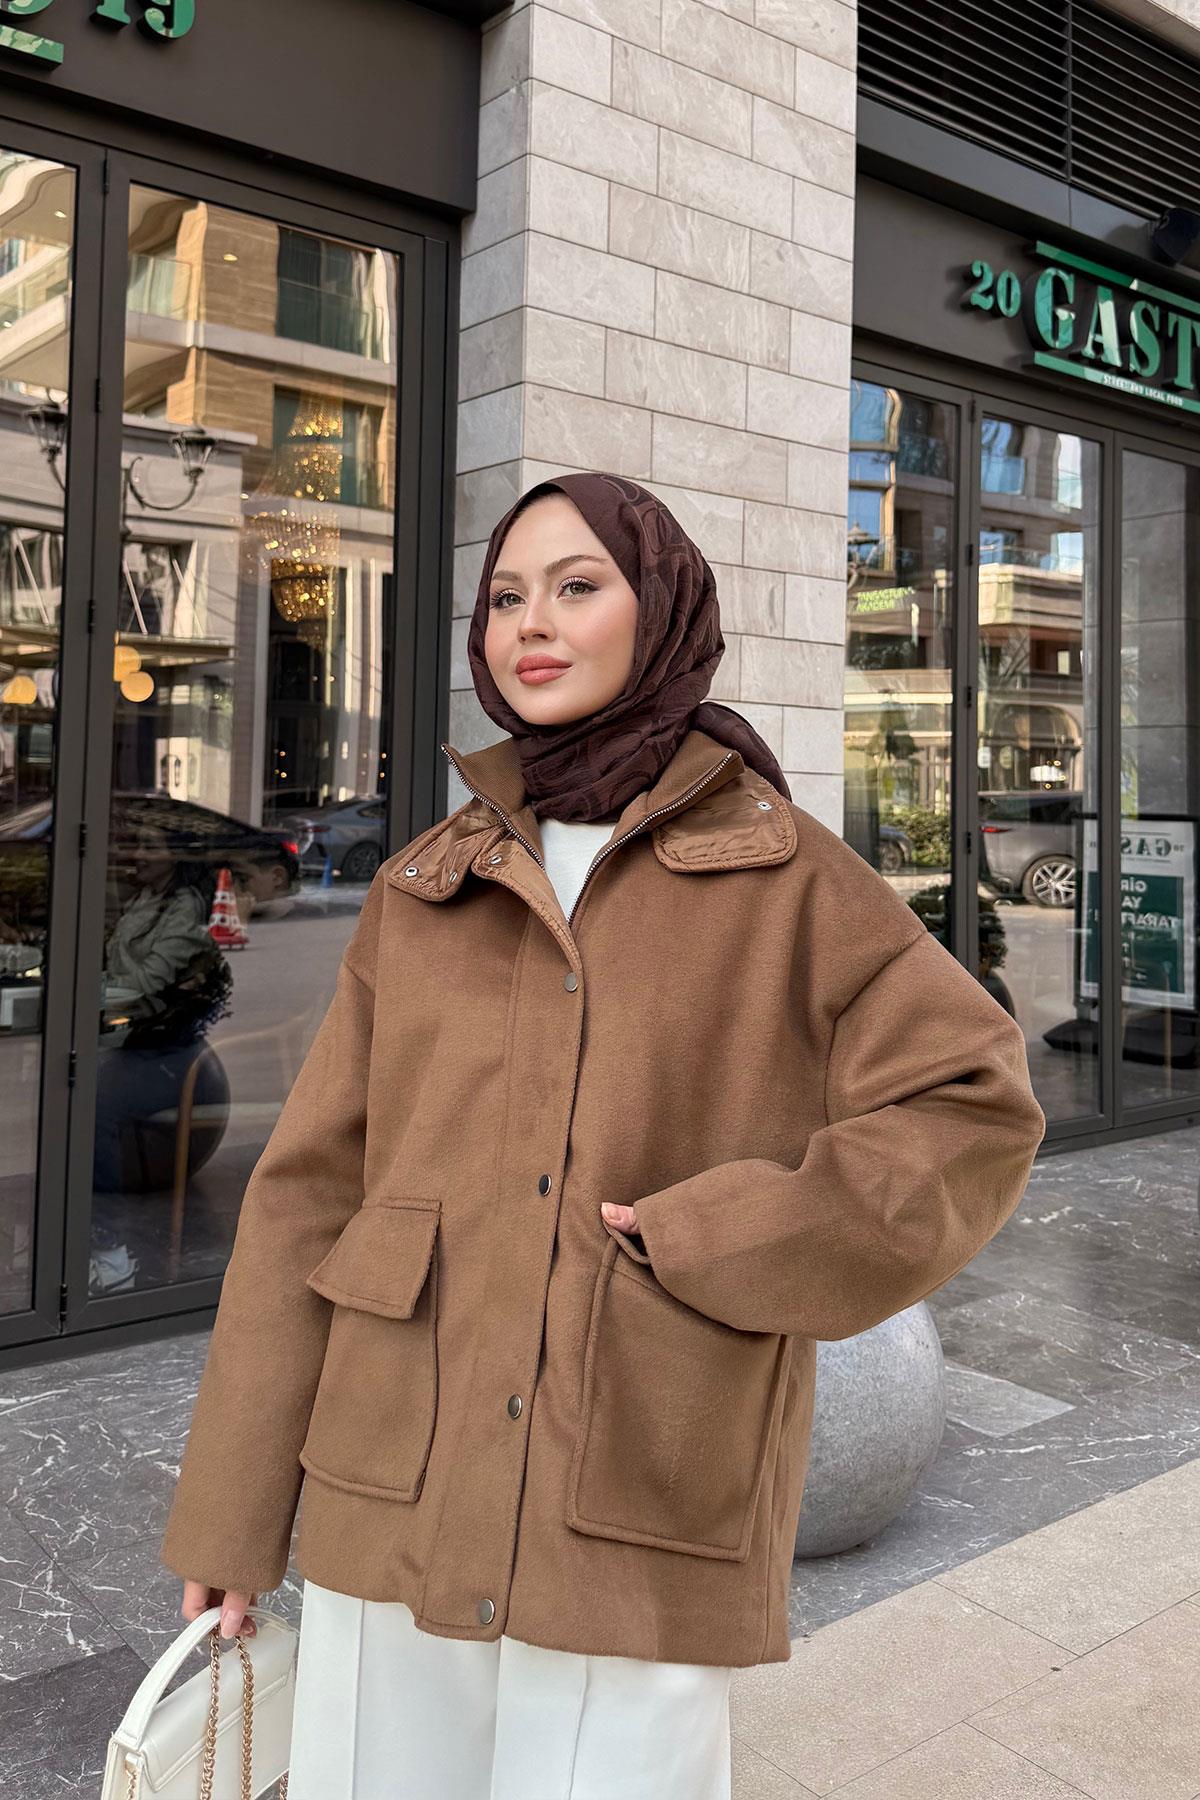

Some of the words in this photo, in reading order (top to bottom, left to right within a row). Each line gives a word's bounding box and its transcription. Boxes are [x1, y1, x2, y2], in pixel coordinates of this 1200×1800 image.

[970, 260, 1021, 318] 20
[1035, 267, 1200, 390] GAST
[1145, 386, 1166, 401] LOCAL
